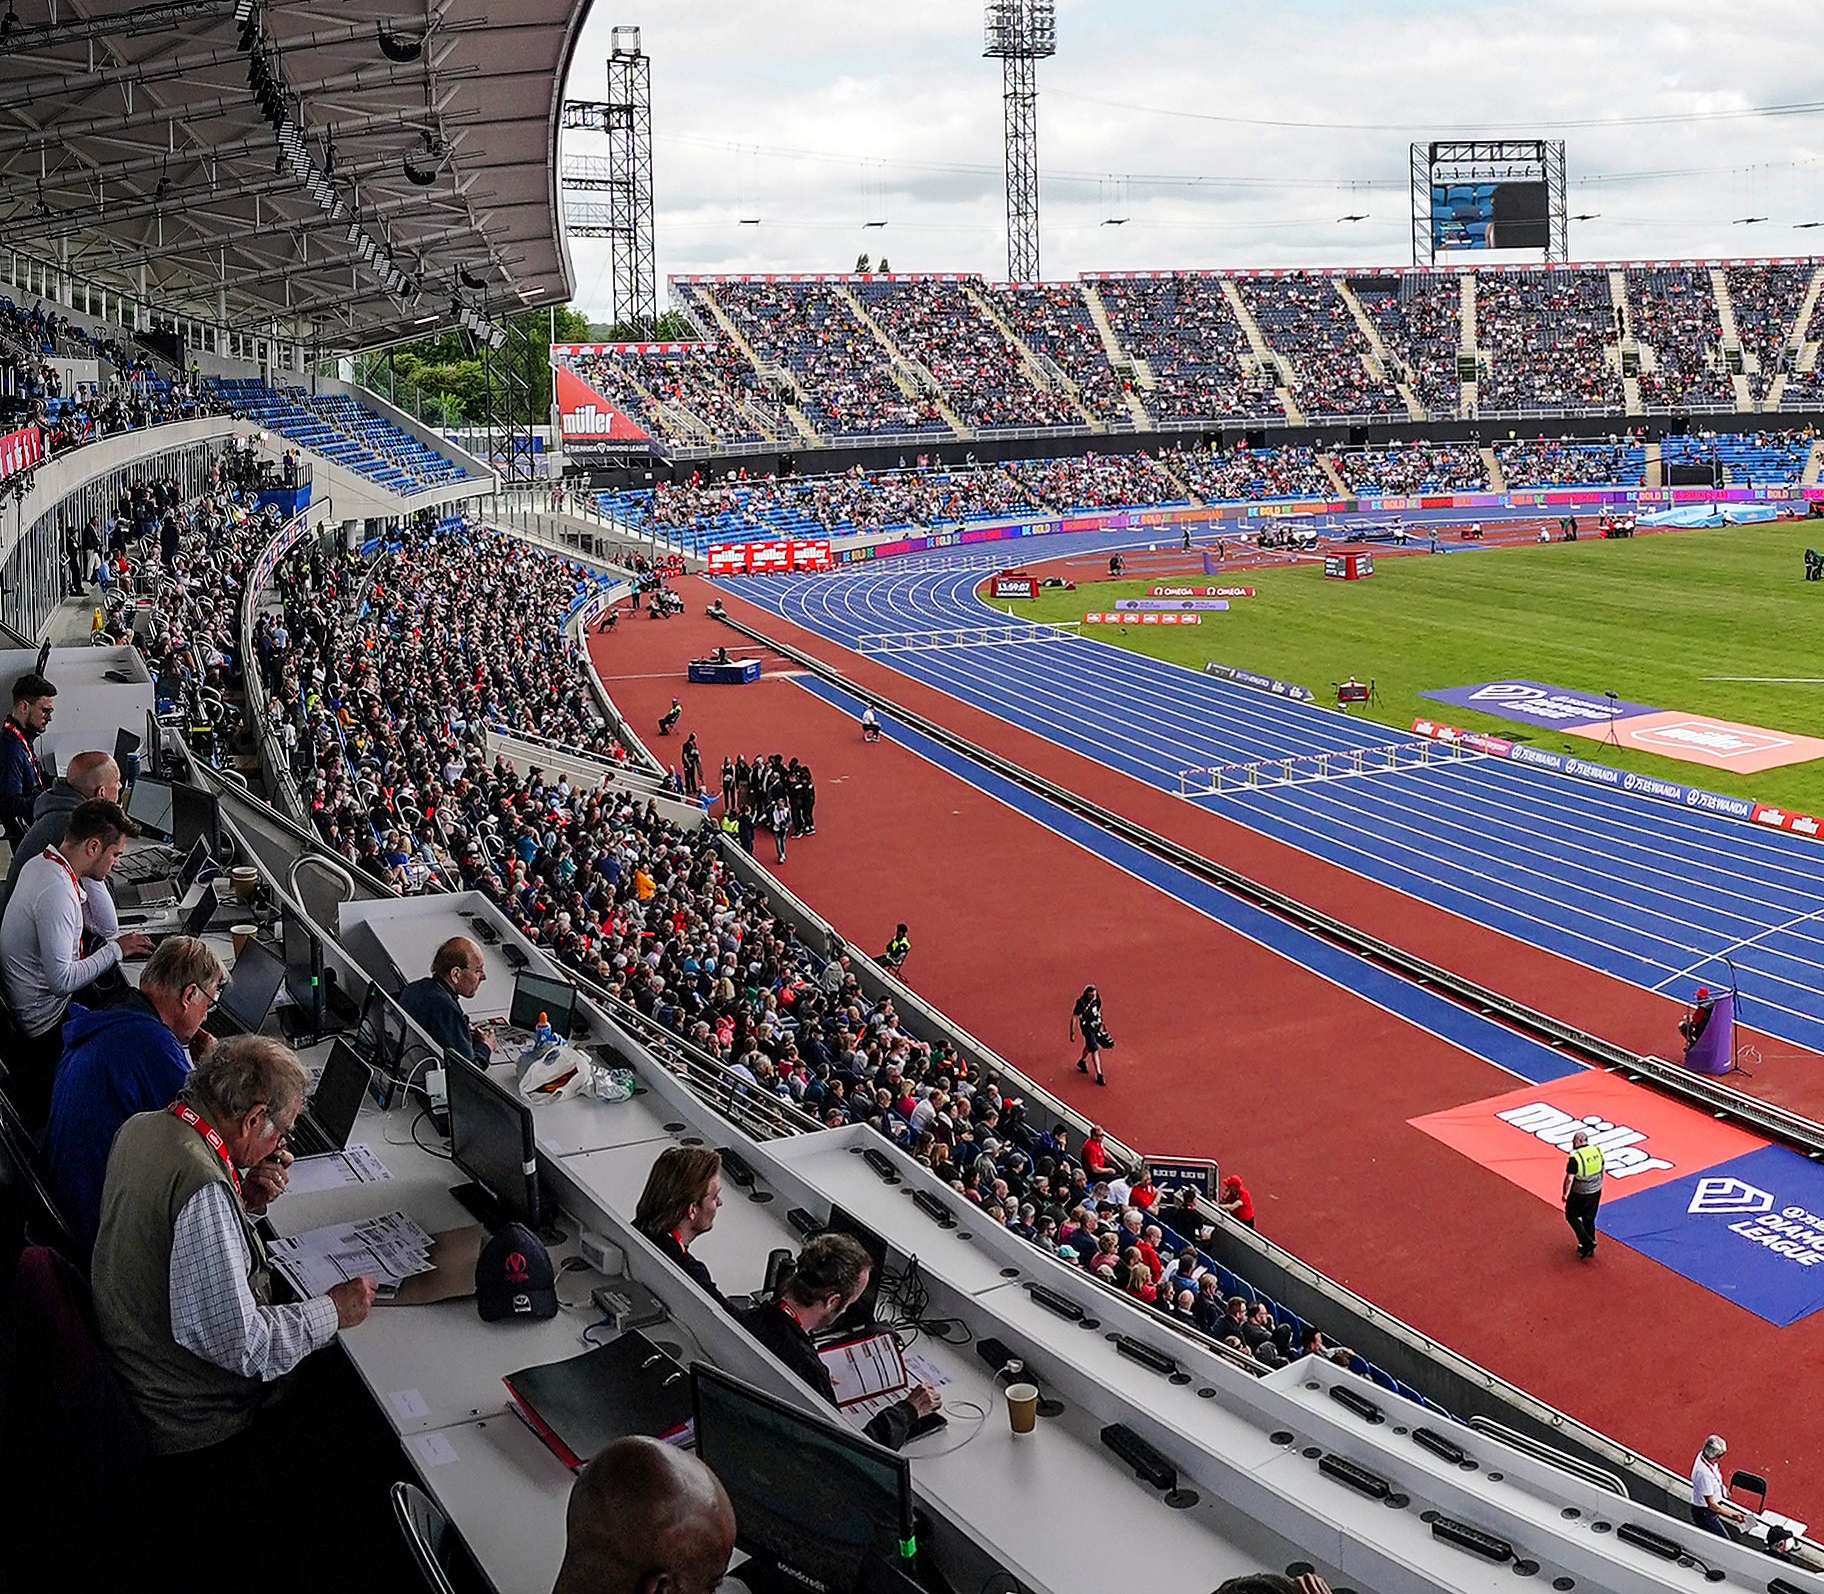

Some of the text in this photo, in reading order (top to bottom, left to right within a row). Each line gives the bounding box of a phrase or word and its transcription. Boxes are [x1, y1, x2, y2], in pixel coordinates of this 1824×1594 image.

[563, 405, 614, 434] müller
[1627, 492, 1637, 500] BE
[1639, 492, 1661, 501] BOLD
[1754, 490, 1788, 499] BE BOLD
[1164, 588, 1246, 596] OMEGA OMEGA
[1655, 727, 1757, 750] müller
[1757, 809, 1820, 835] müller müller
[1494, 1101, 1675, 1179] müller
